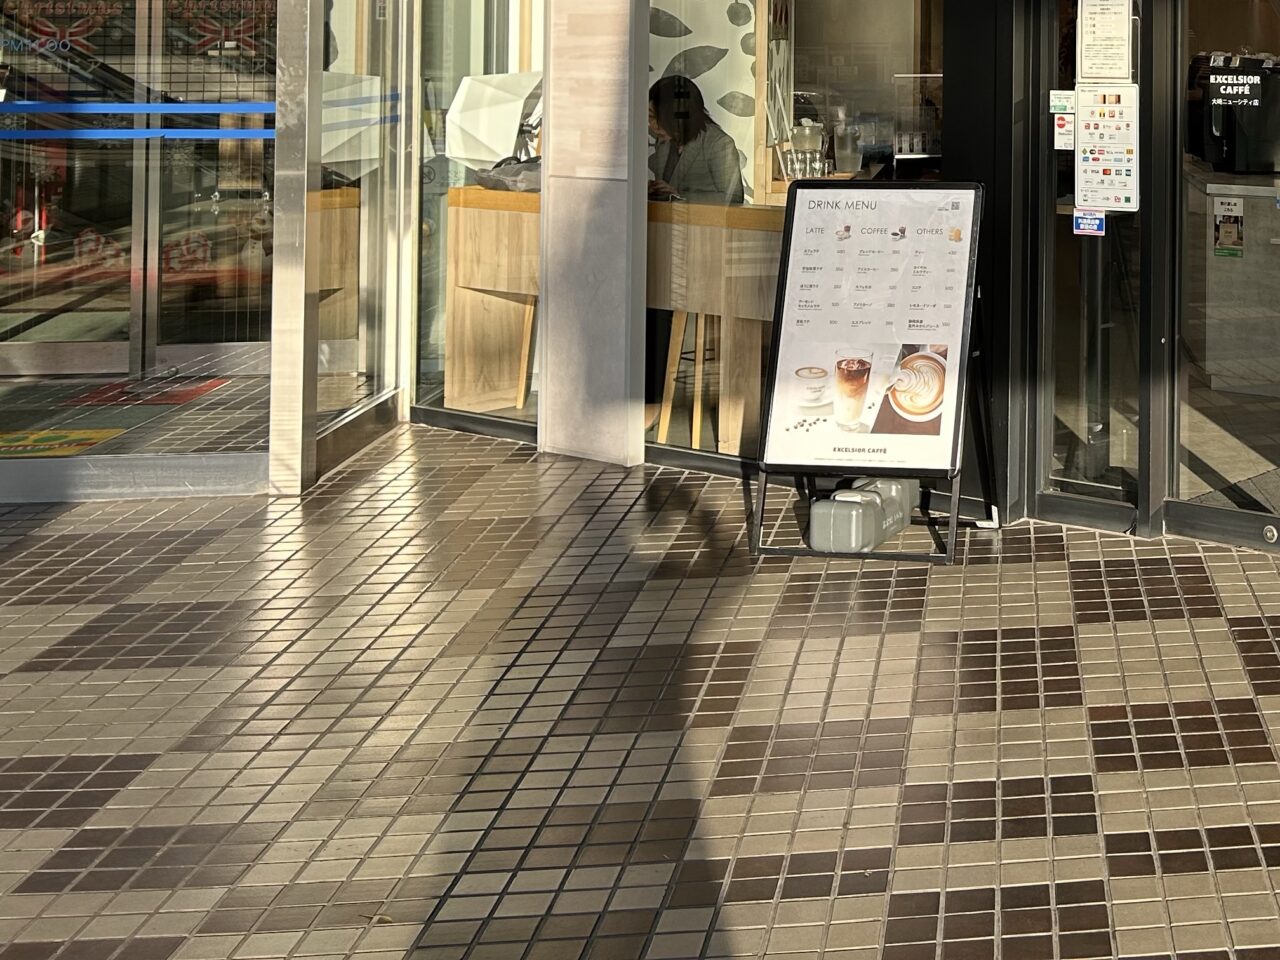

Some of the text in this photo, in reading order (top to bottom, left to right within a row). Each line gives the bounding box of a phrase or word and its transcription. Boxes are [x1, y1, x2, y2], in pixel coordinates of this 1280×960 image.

[1210, 75, 1261, 84] EXCELSIOR
[1220, 84, 1250, 95] CAFFÉ
[1211, 98, 1260, 106] 大崎ニューシティ店
[807, 199, 878, 211] DRINK MENU
[805, 227, 825, 235] LATTE
[860, 227, 888, 235] COFFEE
[833, 446, 887, 455] EXCELSIOR CAFFÉ
